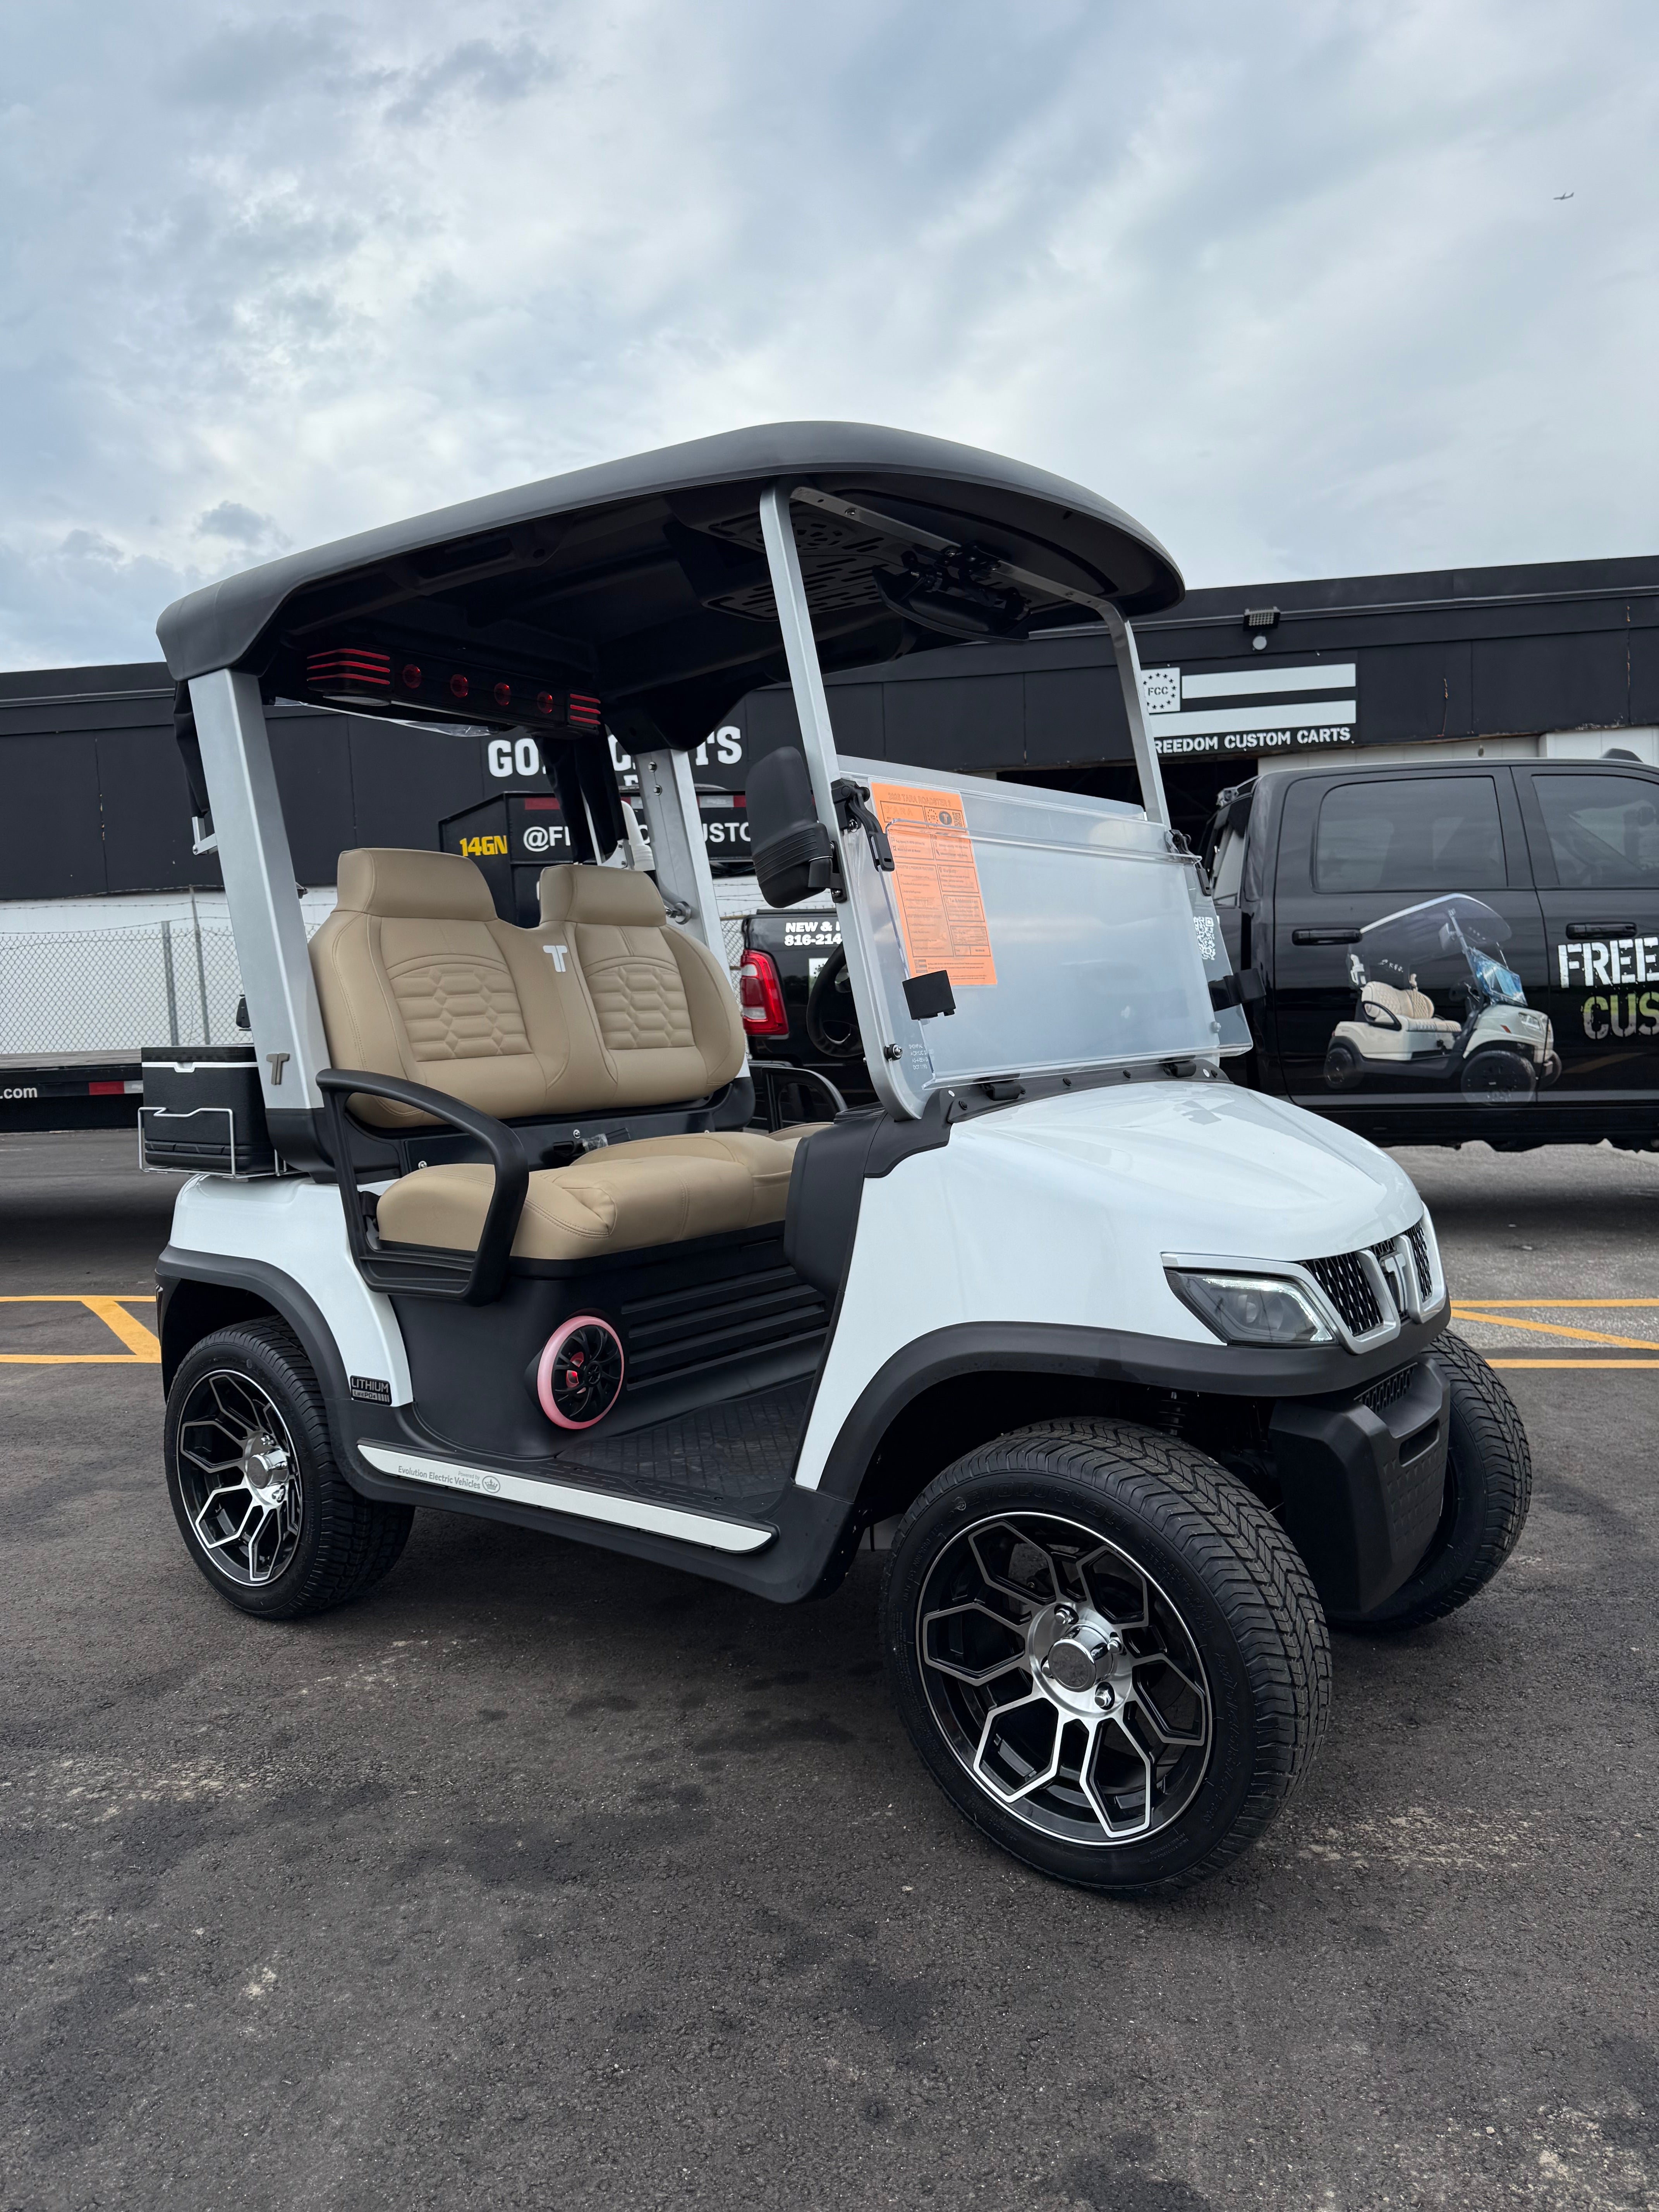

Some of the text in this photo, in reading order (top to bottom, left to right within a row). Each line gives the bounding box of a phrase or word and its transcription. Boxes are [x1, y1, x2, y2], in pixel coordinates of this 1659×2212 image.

[1148, 687, 1168, 696] FCC
[1154, 727, 1350, 754] REEDOM CUSTOM CARTS
[459, 835, 508, 857] 14GN
[785, 922, 818, 933] NEW
[820, 921, 833, 932] &
[351, 1378, 389, 1393] LITHIUM
[398, 1466, 480, 1489] Evolution Electric Vehicles
[965, 1481, 1133, 1532] EVOLUTION
